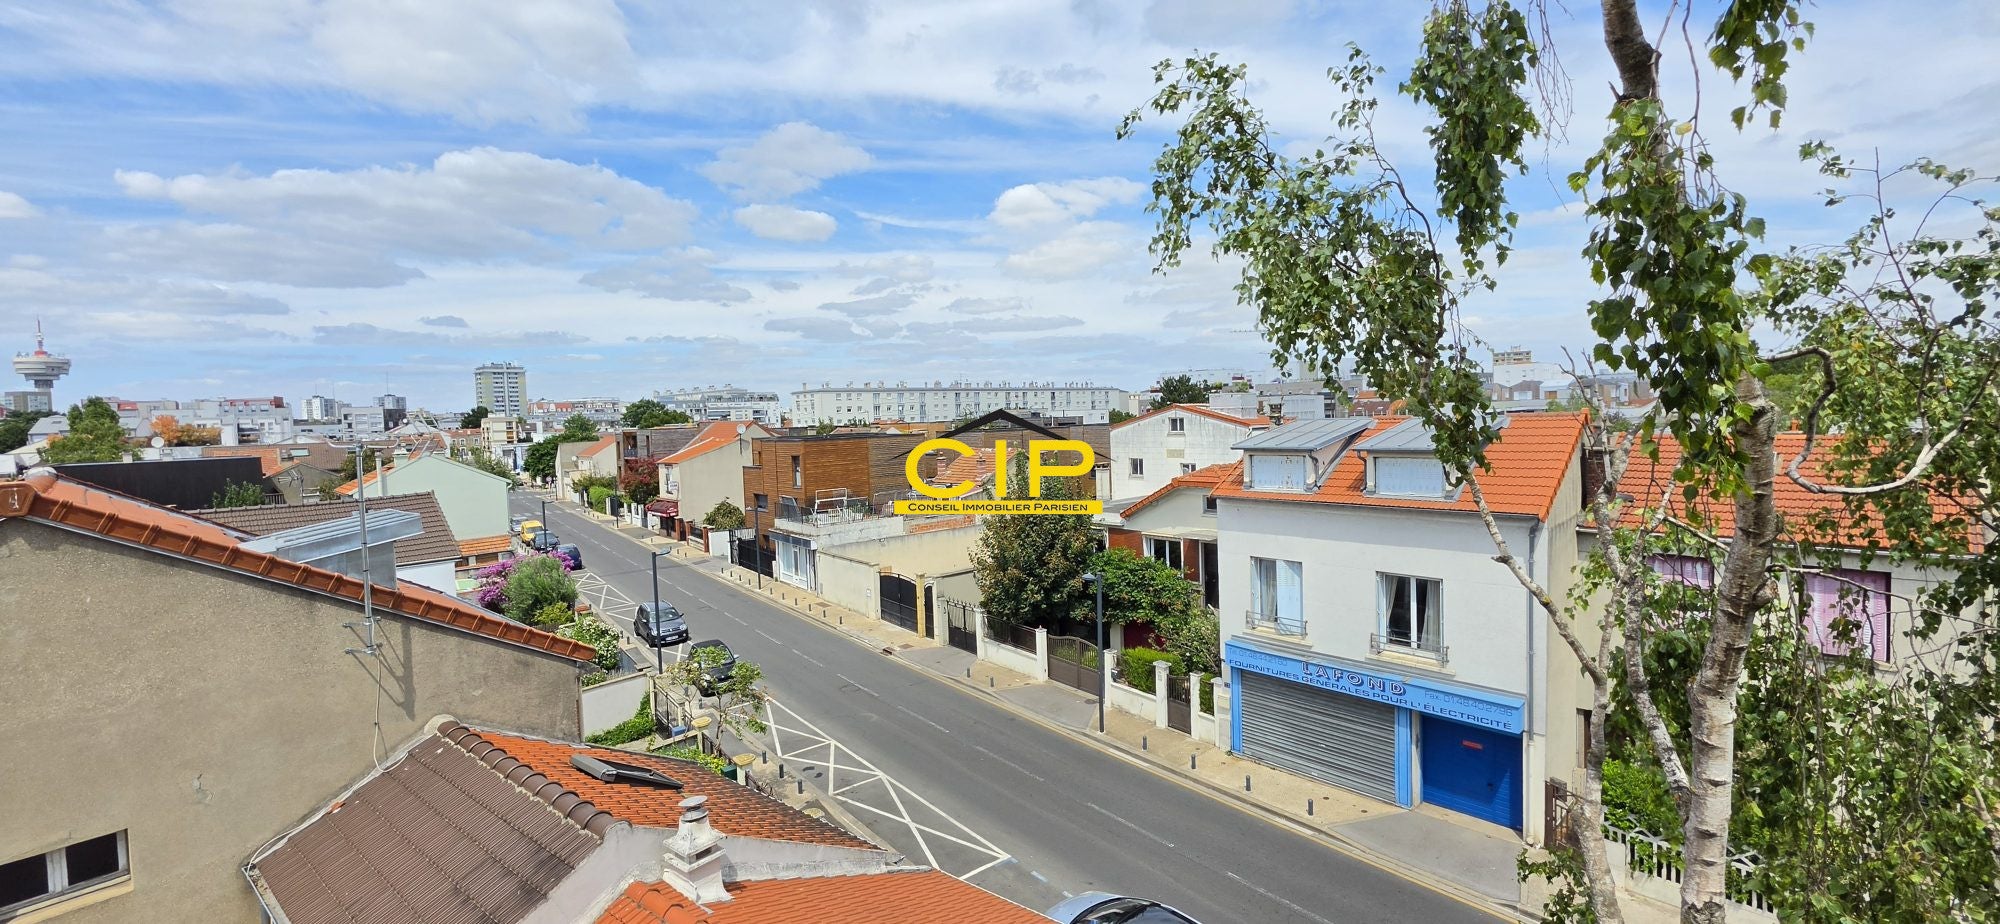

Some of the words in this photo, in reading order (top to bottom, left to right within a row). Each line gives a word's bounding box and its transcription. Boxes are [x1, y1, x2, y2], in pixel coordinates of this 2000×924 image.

[1229, 659, 1300, 680] FOURNITURES
[1372, 691, 1408, 706] POUR
[1423, 702, 1512, 730] ÉLECTRICITÉ
[1301, 661, 1406, 696] LAFOND
